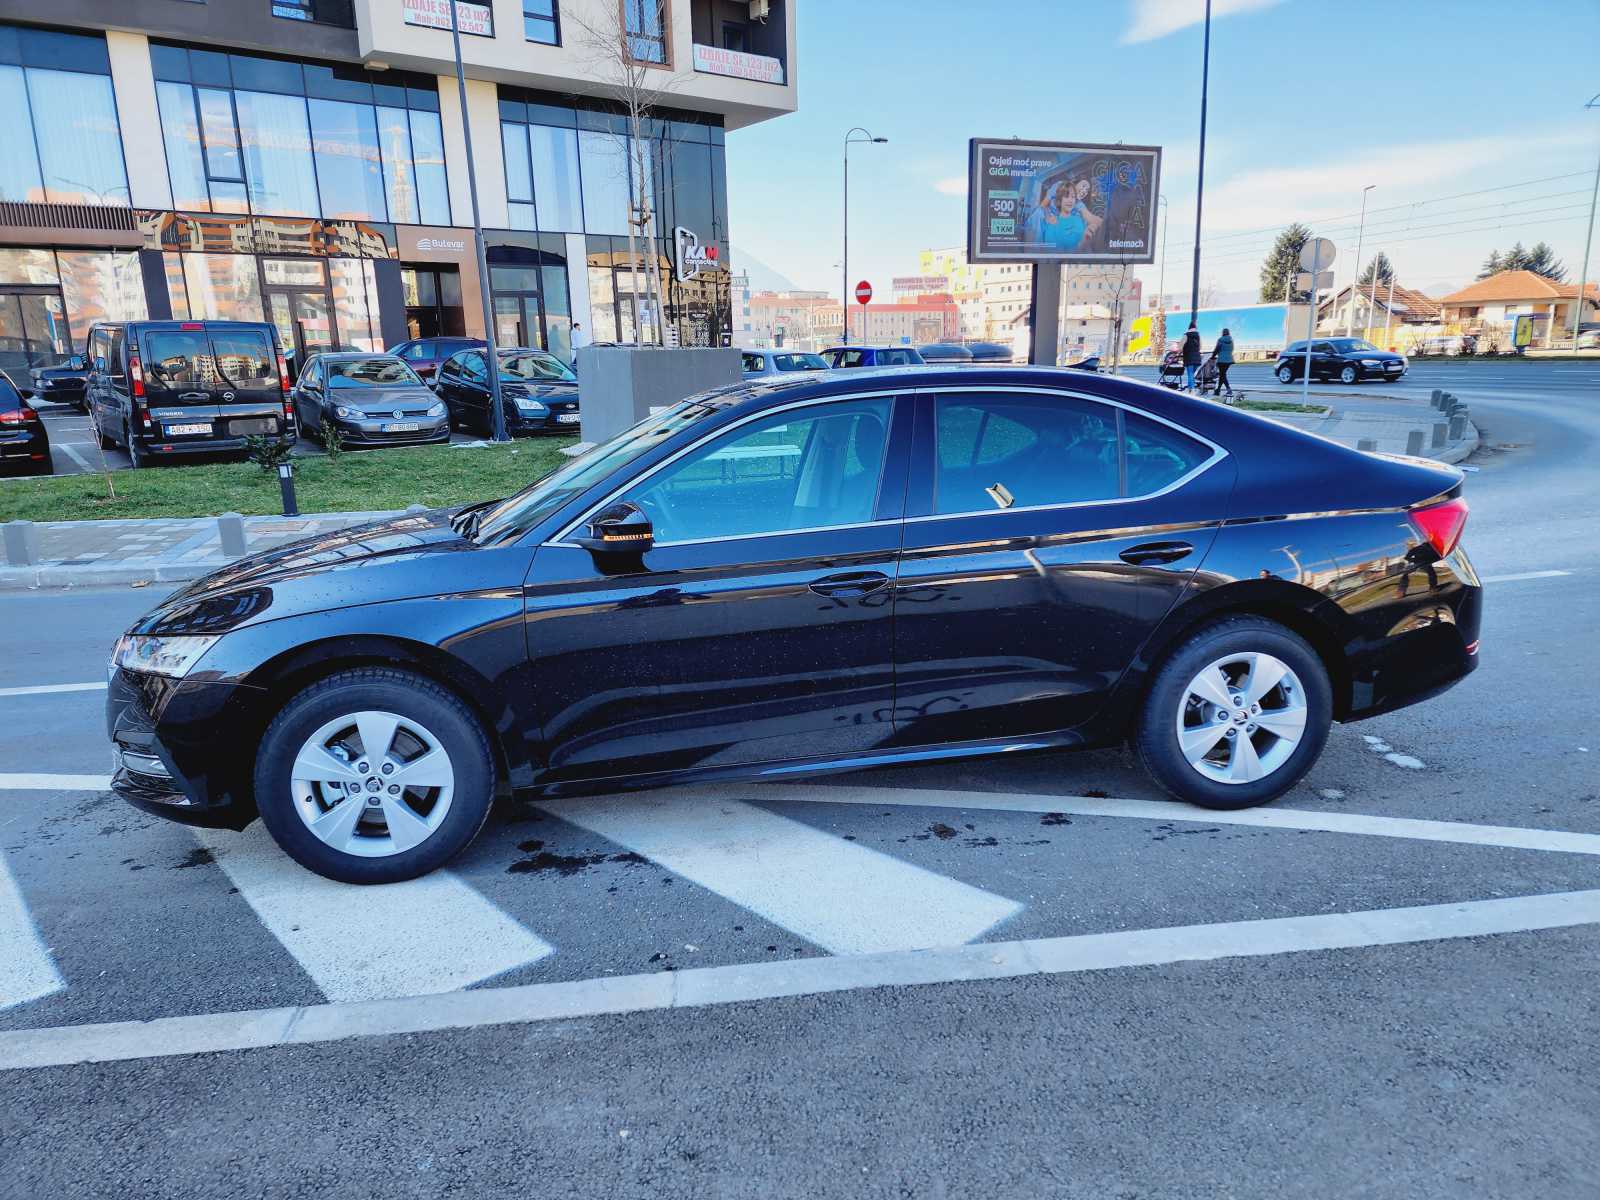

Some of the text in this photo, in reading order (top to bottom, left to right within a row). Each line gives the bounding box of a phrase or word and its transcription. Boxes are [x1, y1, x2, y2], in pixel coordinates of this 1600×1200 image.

[988, 155, 1012, 167] Osjeti
[988, 167, 1009, 176] GIGA
[1109, 239, 1144, 248] telemach
